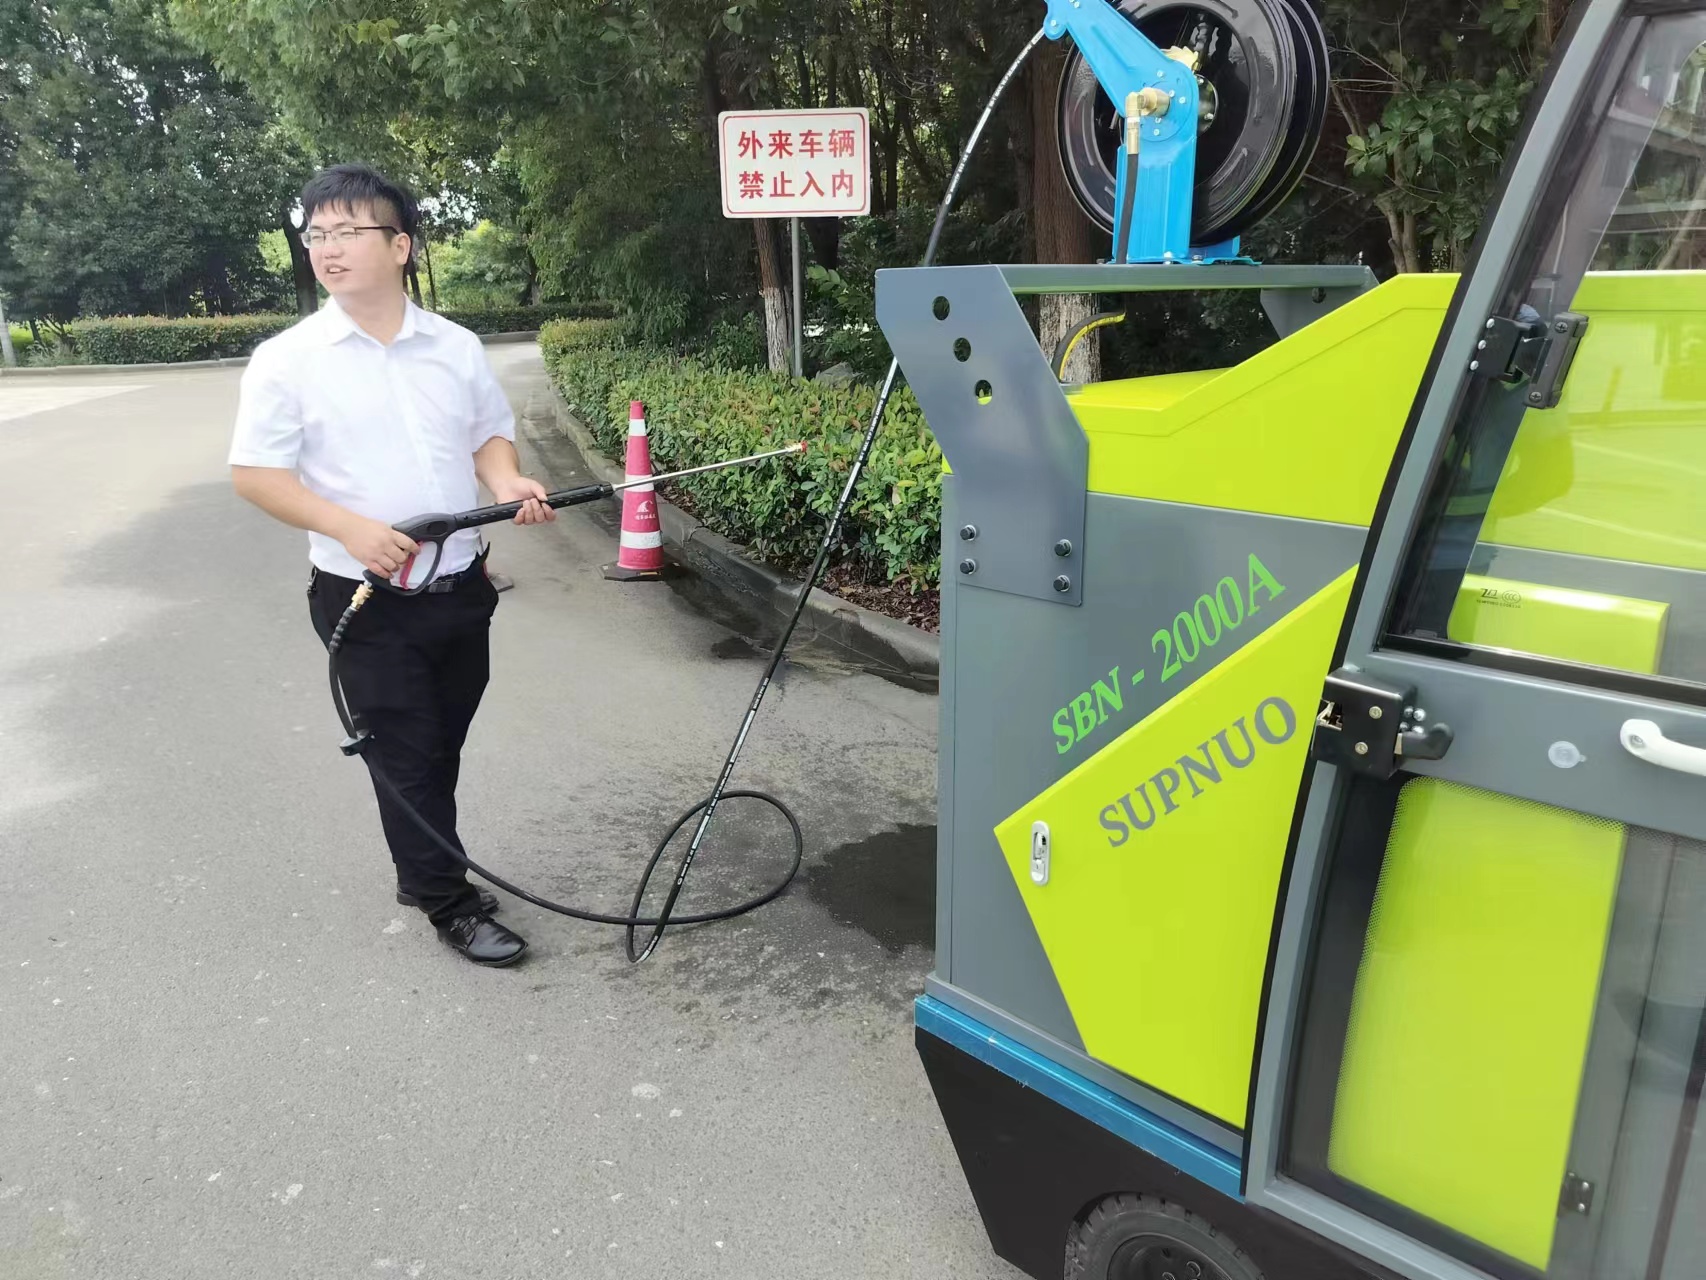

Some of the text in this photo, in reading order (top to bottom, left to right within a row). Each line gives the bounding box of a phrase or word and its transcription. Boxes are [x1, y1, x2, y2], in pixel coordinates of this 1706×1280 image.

[738, 129, 855, 159] 外来车辆
[739, 169, 853, 199] 禁止入内
[1052, 666, 1123, 754] SBN
[1151, 553, 1286, 683] 2000A
[1098, 696, 1297, 847] SUPNUO
